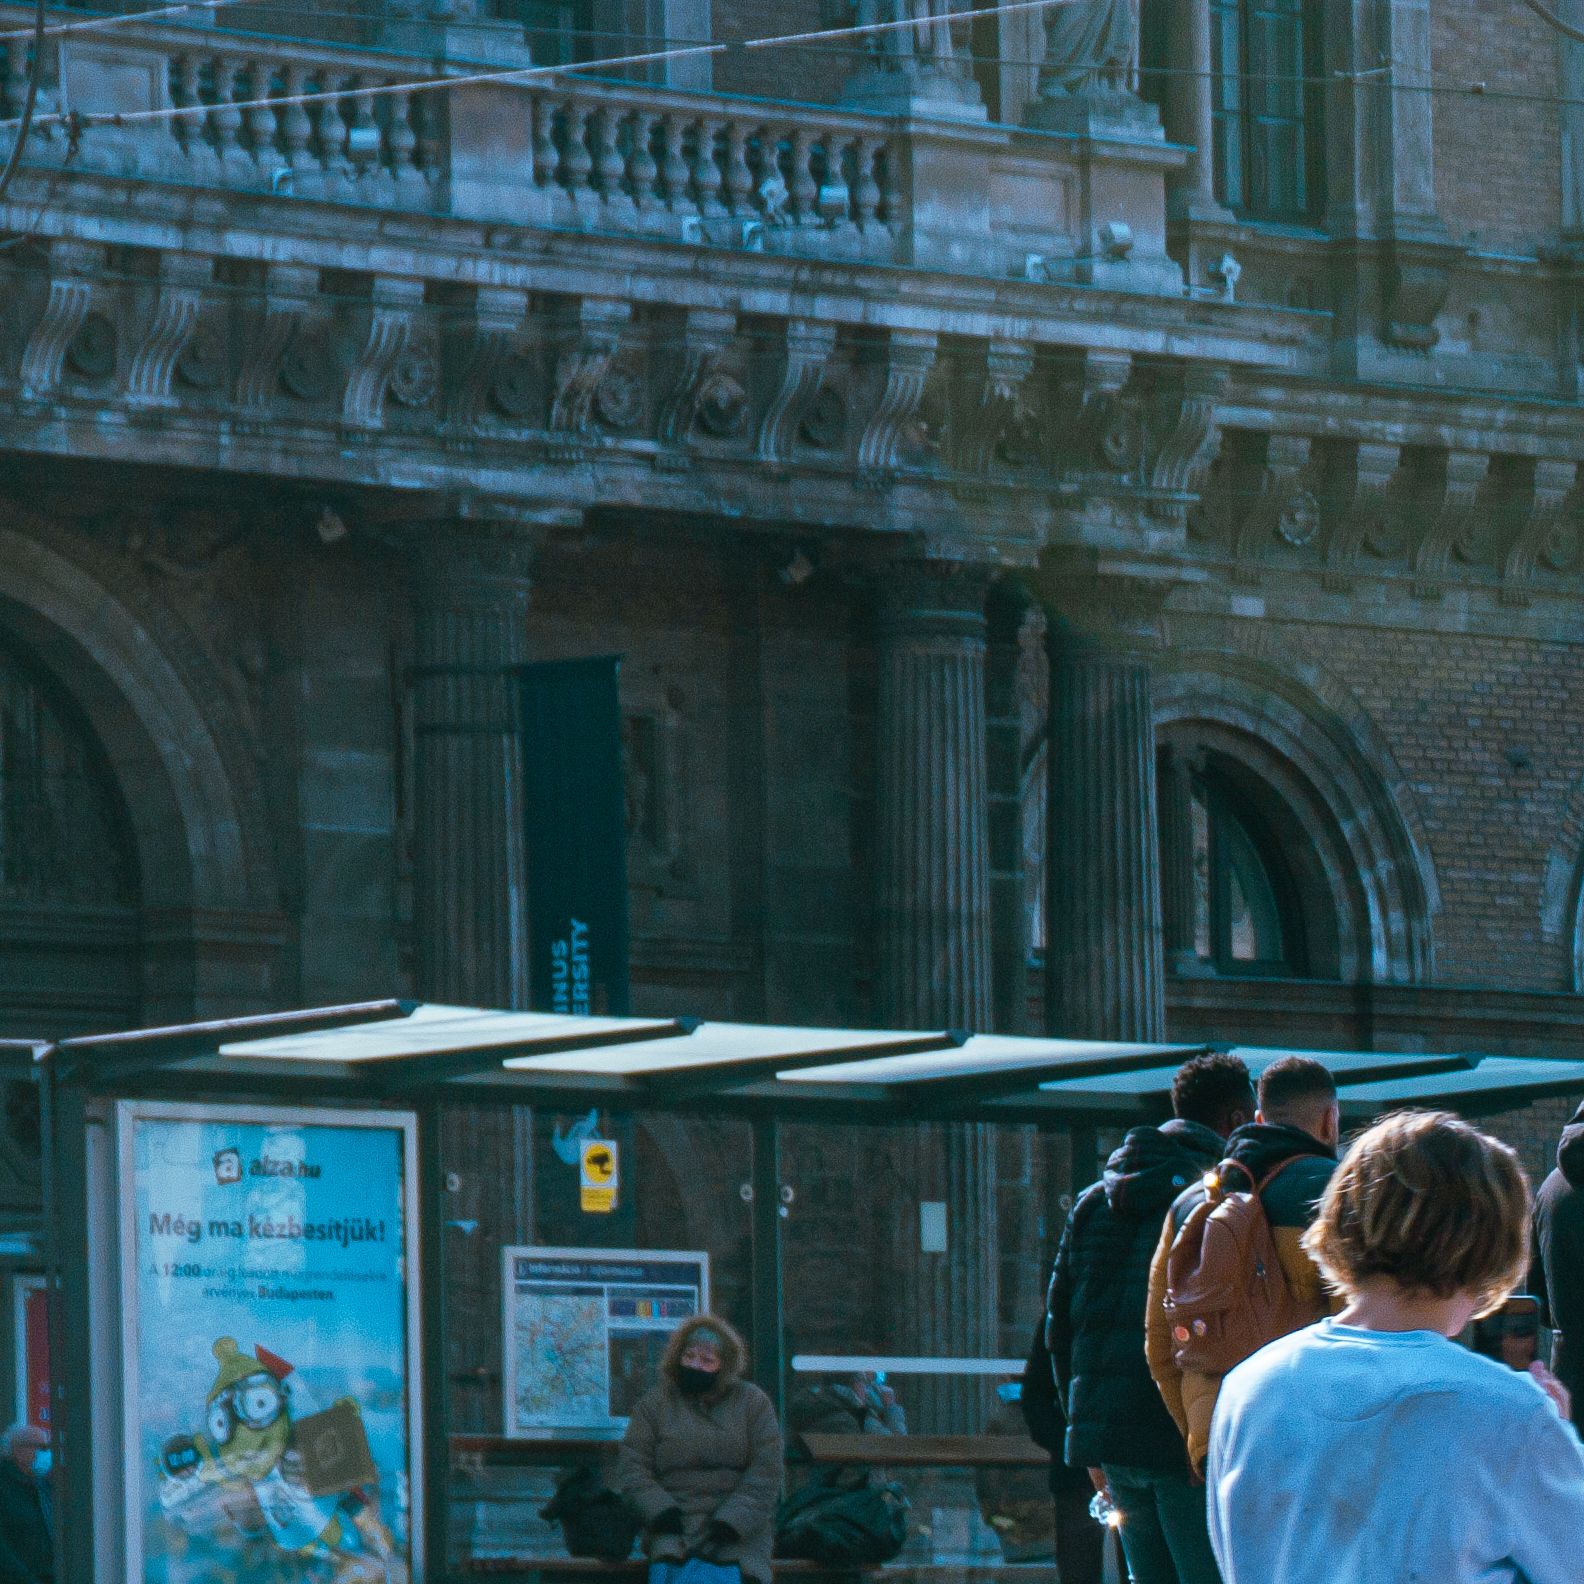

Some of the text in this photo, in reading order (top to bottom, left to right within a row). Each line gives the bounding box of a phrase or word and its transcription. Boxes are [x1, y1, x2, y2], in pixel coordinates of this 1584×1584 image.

[150, 1213, 385, 1247] Még ma kézbesítjük!
[164, 1264, 199, 1277] 12:00
